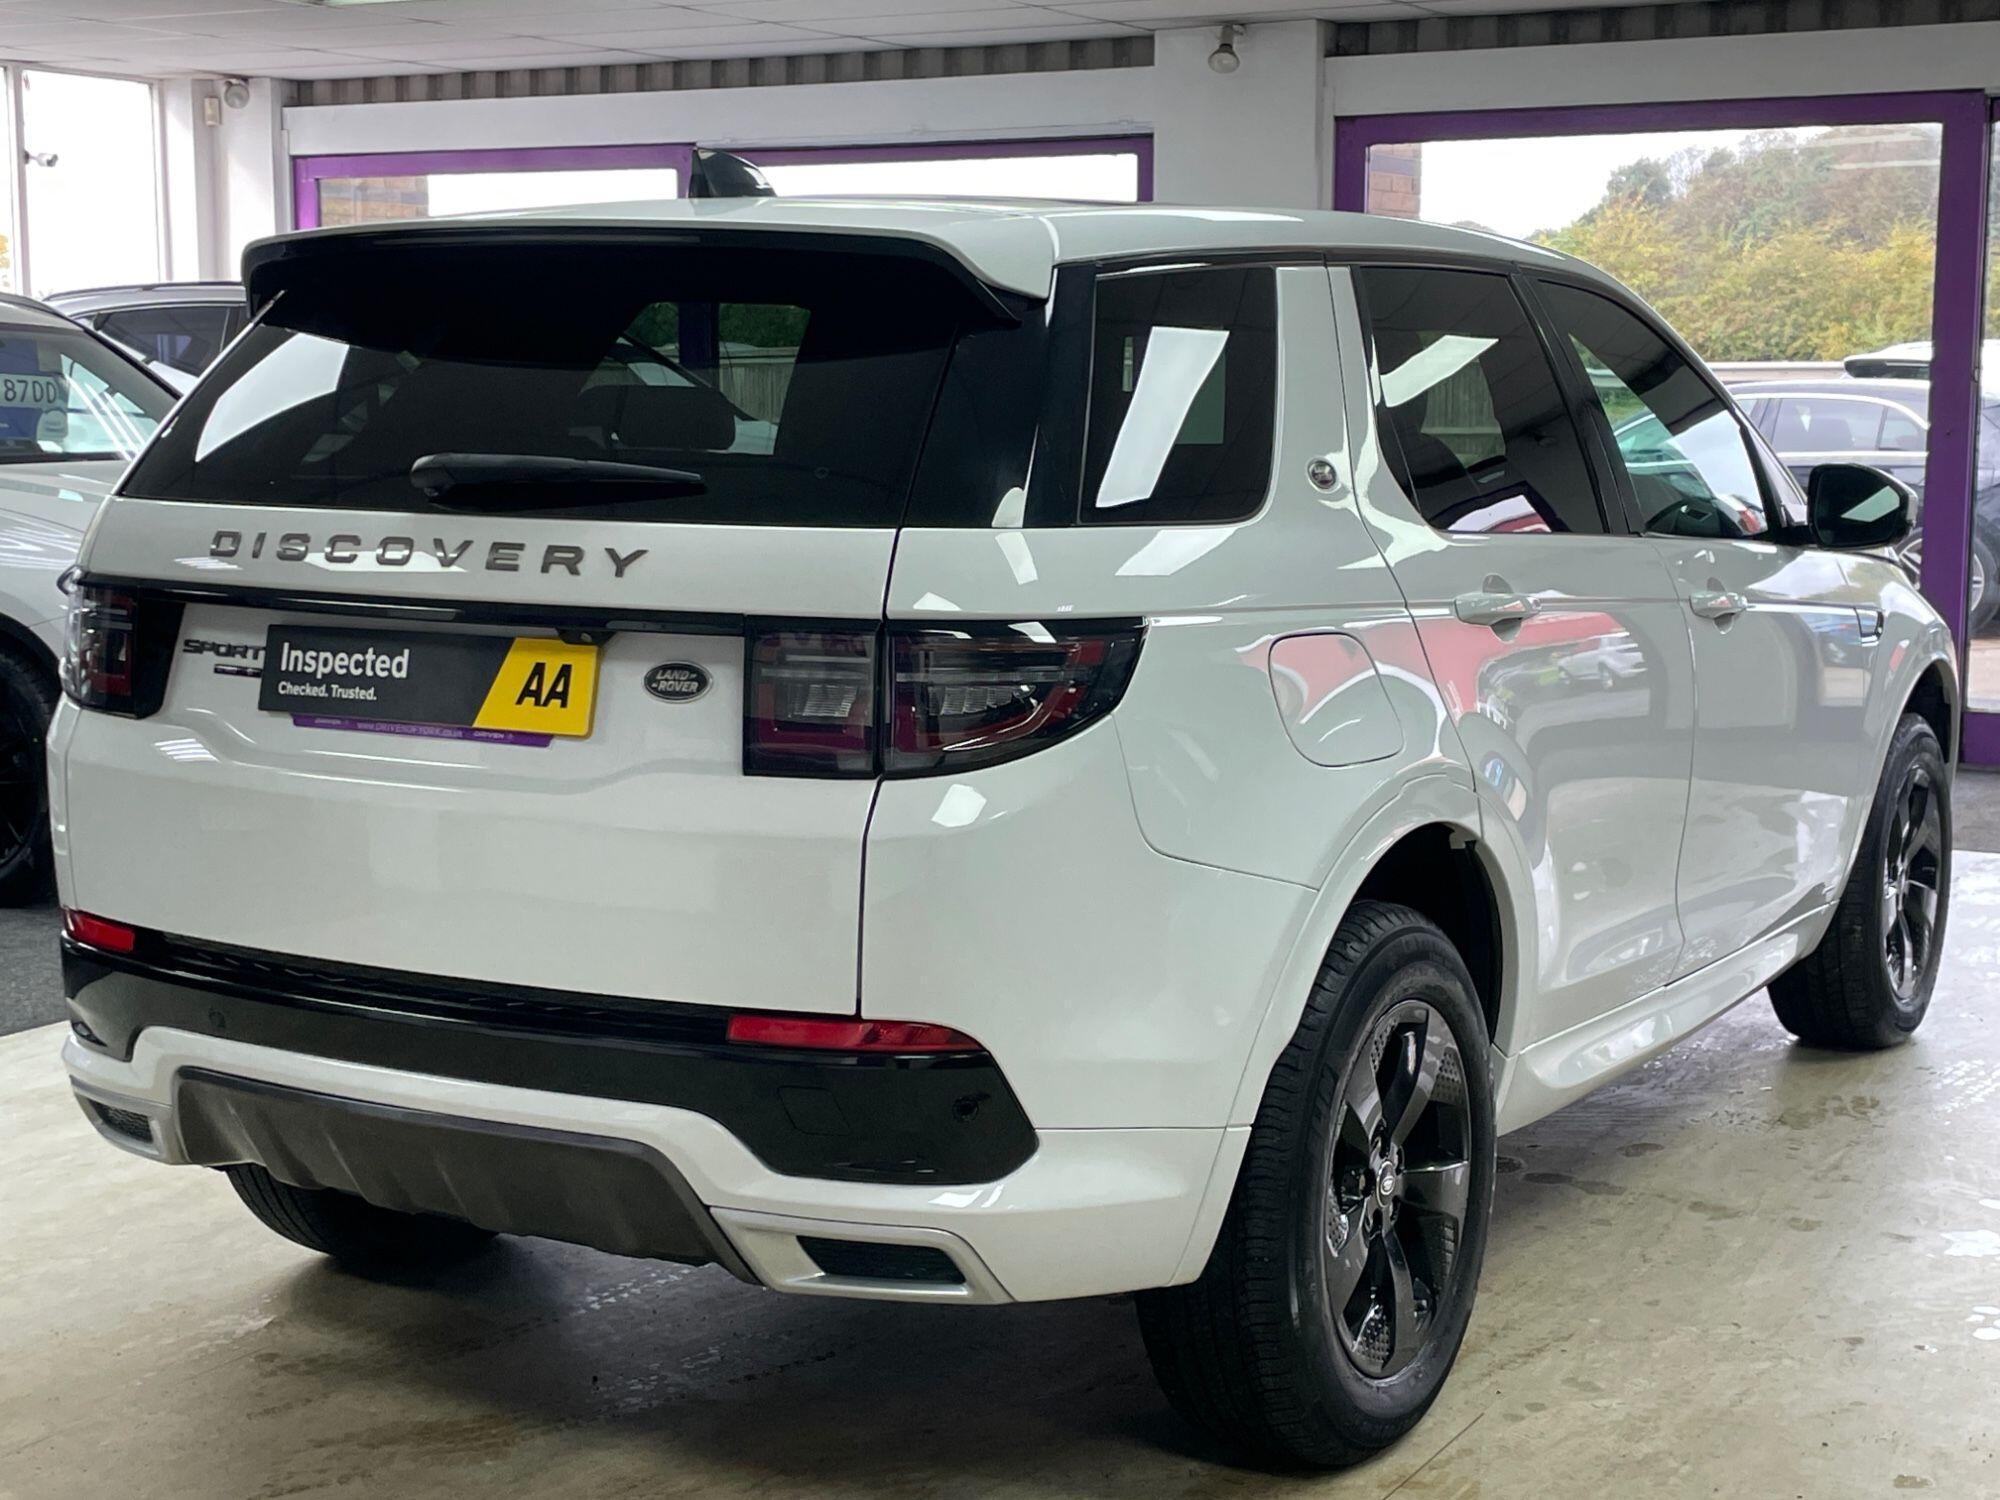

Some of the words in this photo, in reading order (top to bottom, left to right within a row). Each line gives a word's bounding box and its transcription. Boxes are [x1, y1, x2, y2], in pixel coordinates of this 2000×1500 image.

[209, 529, 649, 579] DISCOVERY
[182, 639, 266, 660] SPORT
[280, 641, 411, 679] Inspected
[515, 662, 573, 709] AA
[656, 670, 689, 680] LAND
[278, 681, 329, 698] Checked.
[331, 684, 377, 701] Trusted.
[658, 680, 699, 692] ROVER
